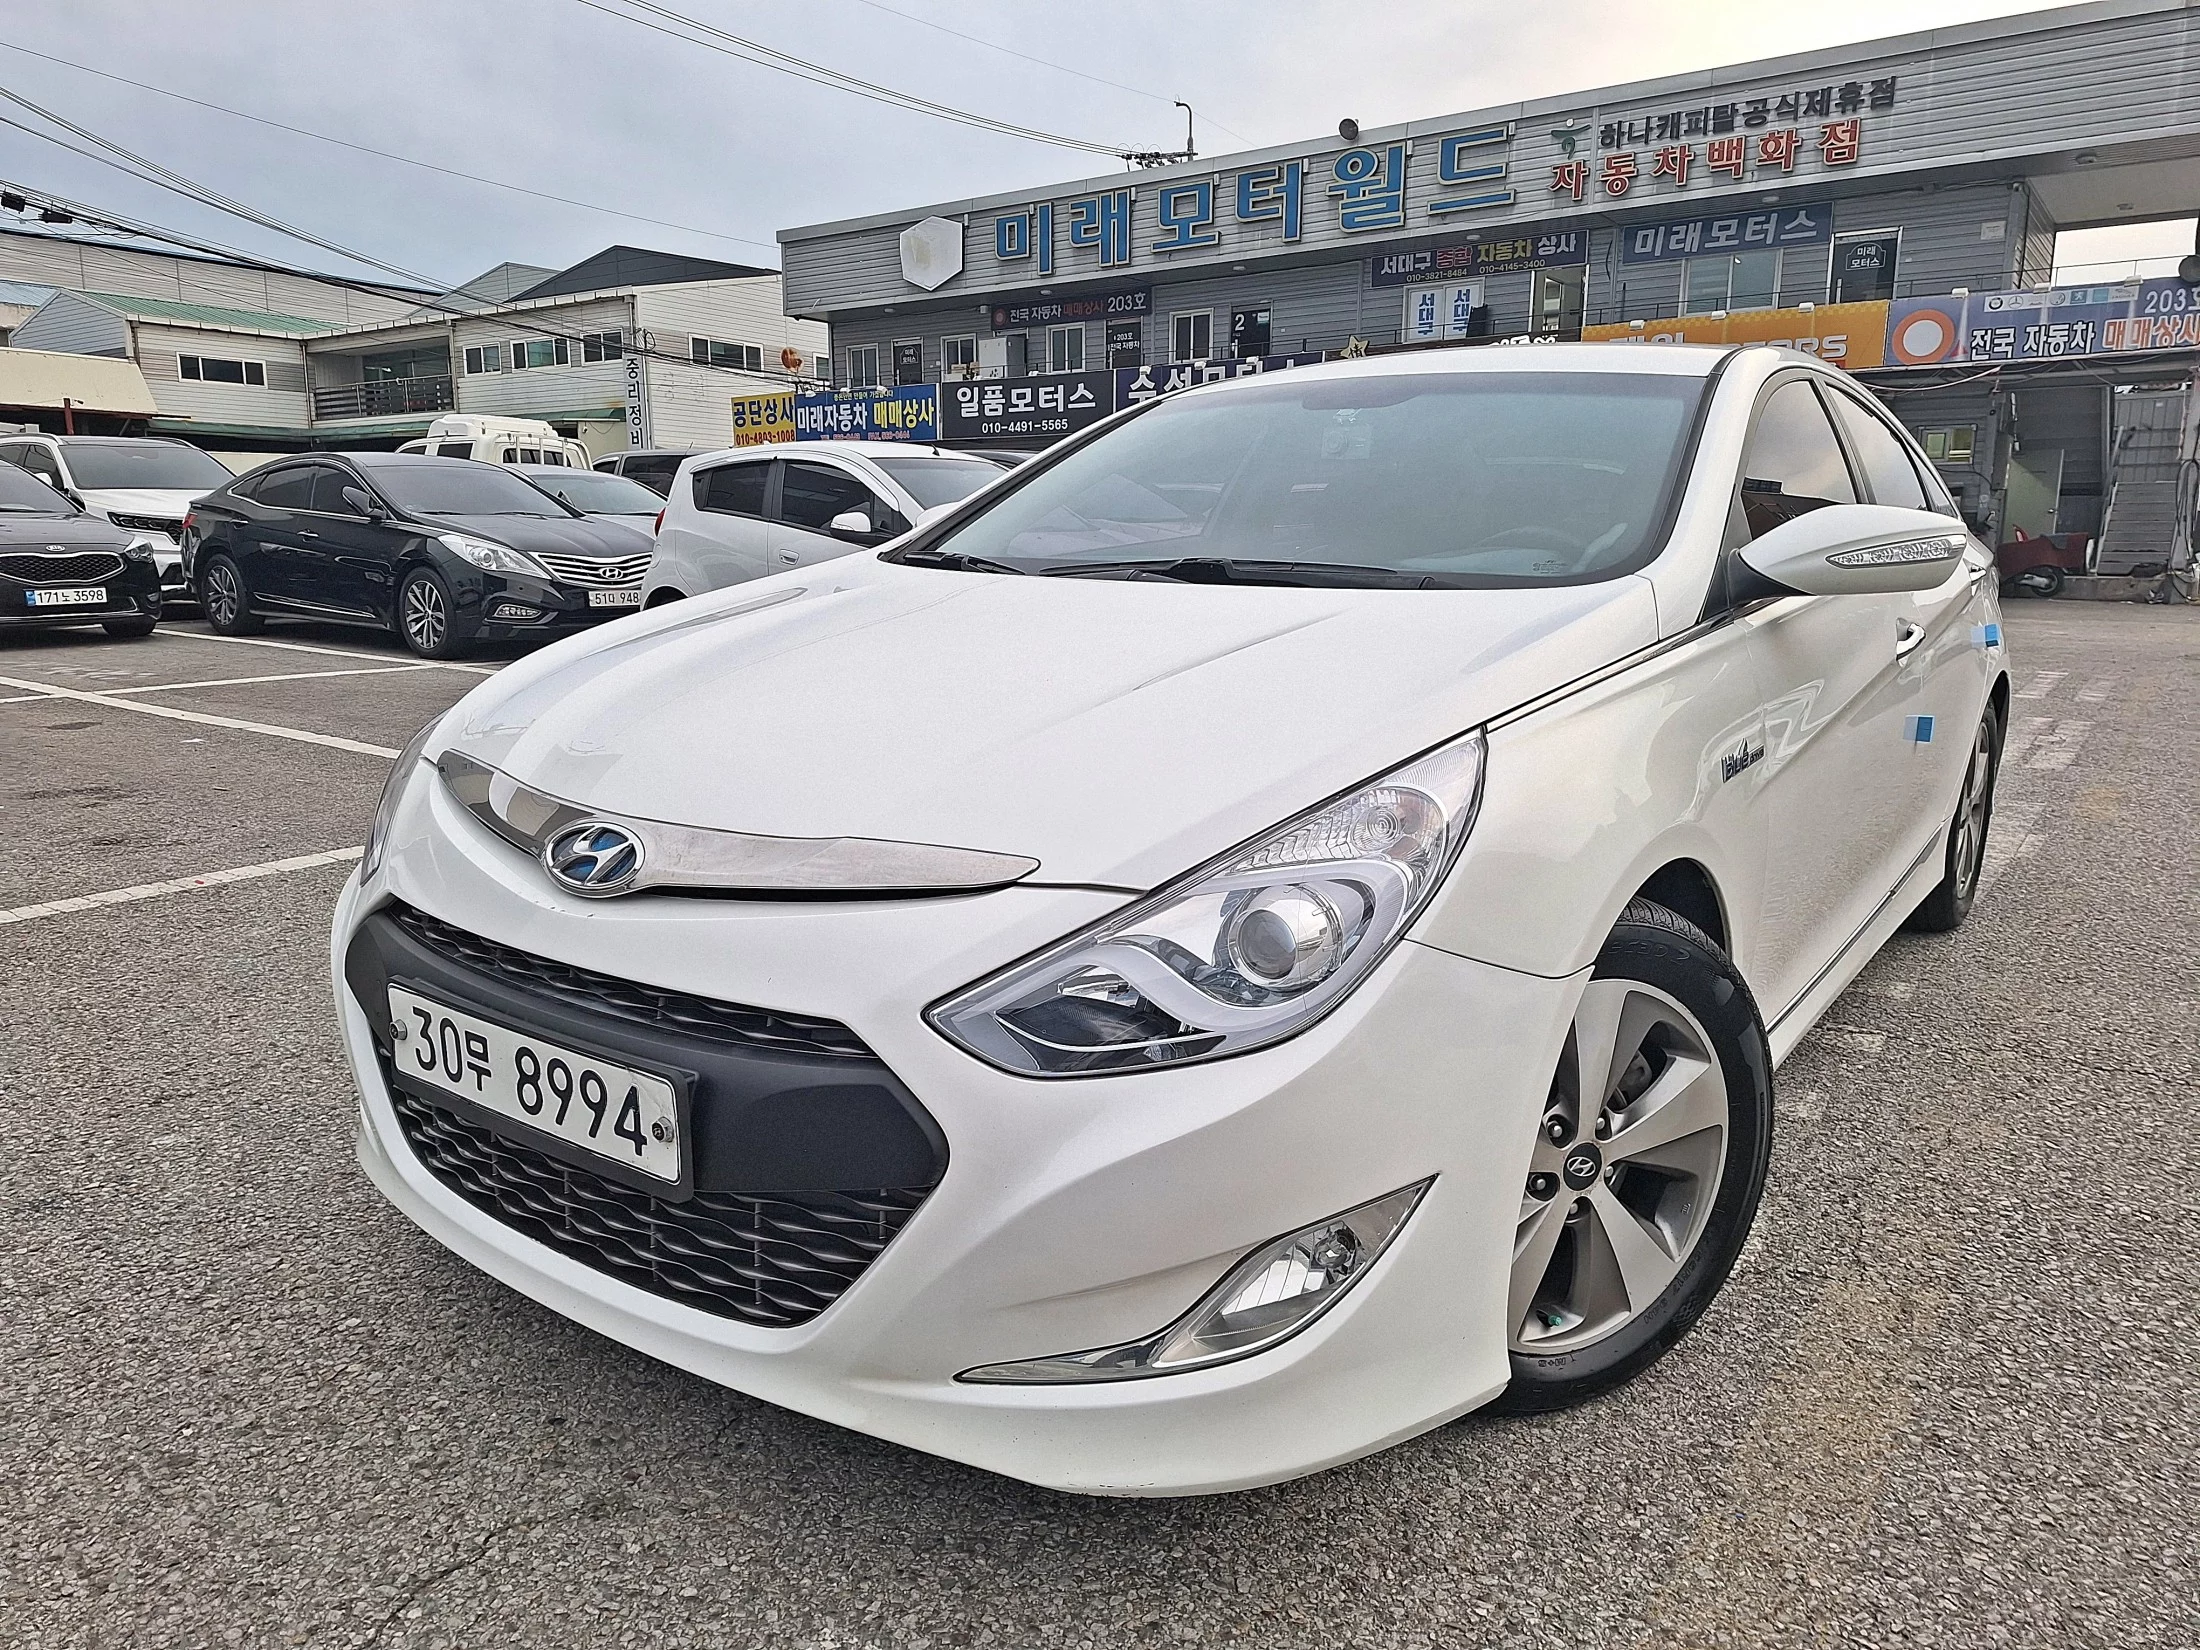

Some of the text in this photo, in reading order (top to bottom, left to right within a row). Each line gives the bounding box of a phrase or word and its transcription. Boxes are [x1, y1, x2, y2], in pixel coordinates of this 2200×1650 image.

[994, 126, 1515, 275] 미래모터월드
[1634, 210, 1817, 257] 미래모터스
[1381, 233, 1576, 275] 서대구 종합 자동차 상사
[1850, 257, 1880, 268] 모터스
[1857, 246, 1876, 256] 미래
[1406, 259, 1546, 282] 010-3821-8484 010-4145-3400
[1010, 291, 1147, 323] 전국 자동차 매매상사 203호
[1235, 314, 1245, 331] 2
[1970, 313, 2200, 361] 전국 자동차 매매상사
[626, 358, 644, 449] 중리정비
[733, 397, 794, 428] 공단상사
[797, 397, 934, 433] 미래자동차 매매상사
[956, 383, 1096, 418] 일품모터스
[735, 429, 795, 446] 010-4803-1008
[982, 418, 1068, 434] 010-4491-5565
[37, 589, 104, 604] 171노 3598
[412, 1005, 648, 1157] 30무 8994
